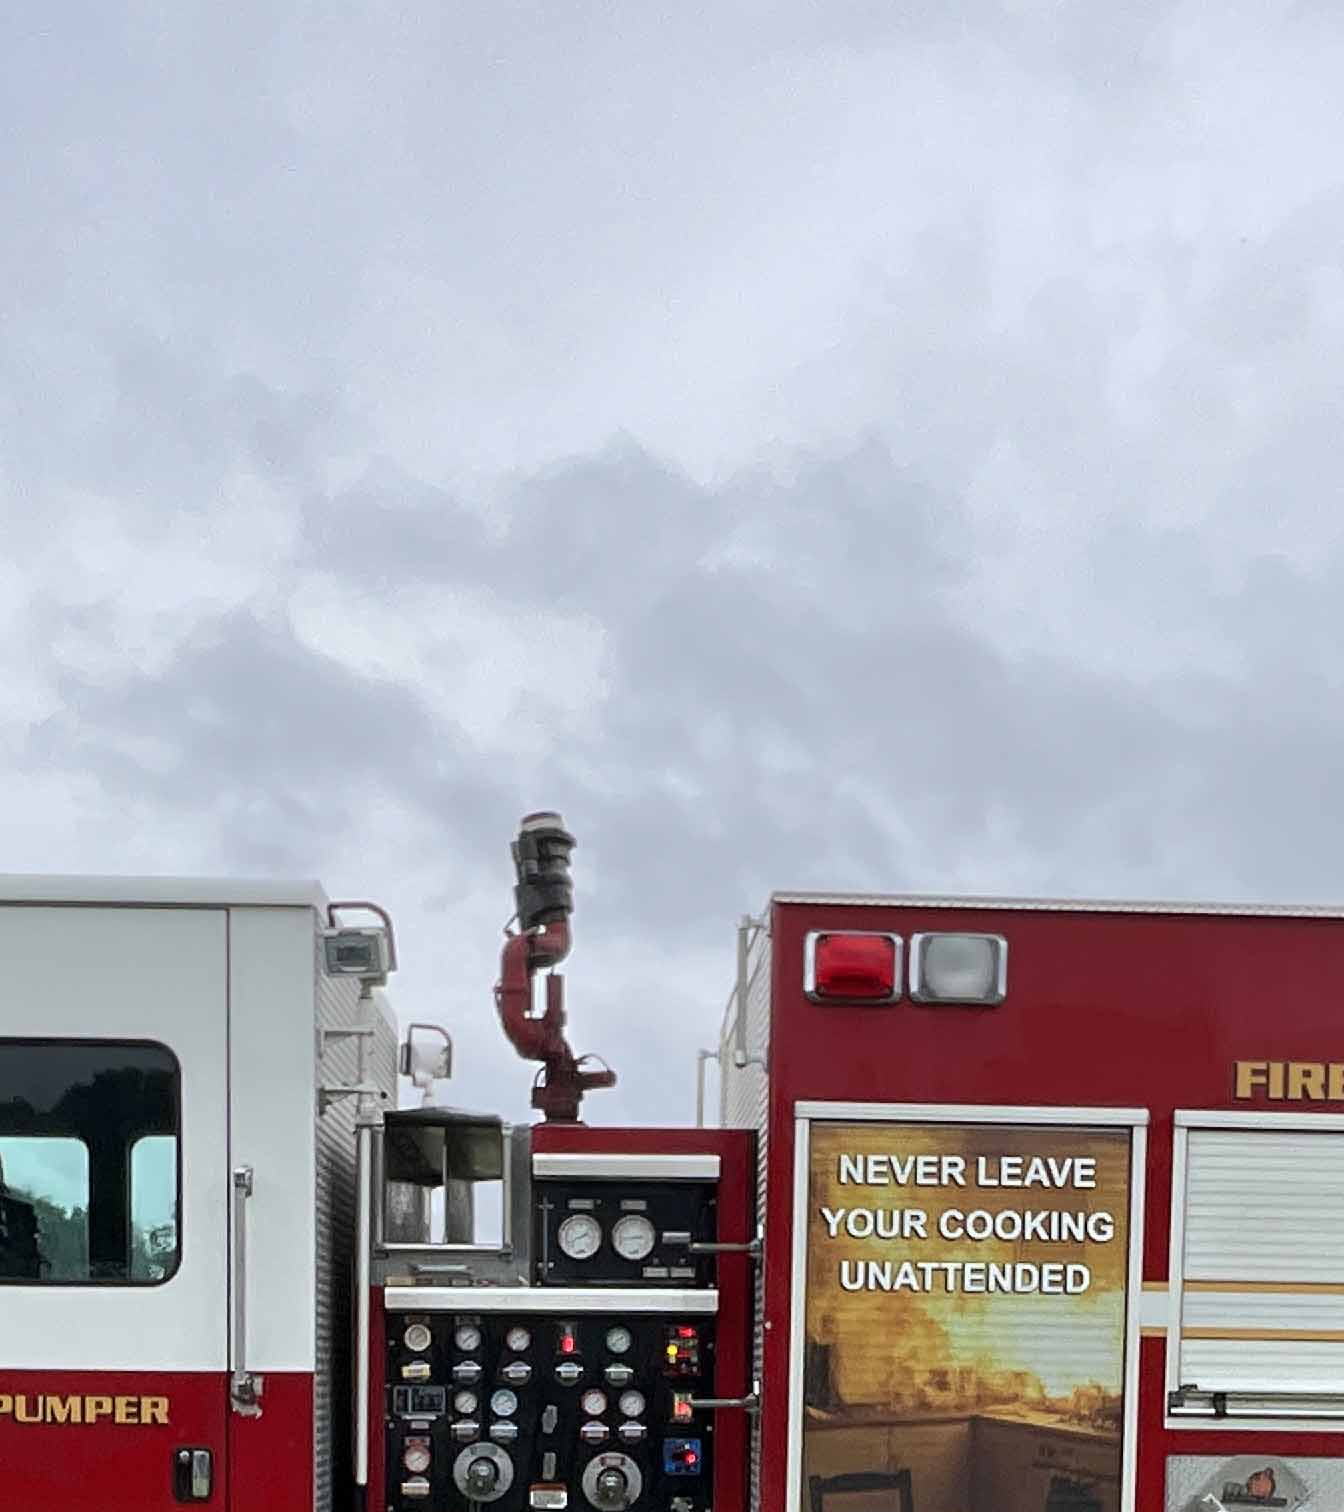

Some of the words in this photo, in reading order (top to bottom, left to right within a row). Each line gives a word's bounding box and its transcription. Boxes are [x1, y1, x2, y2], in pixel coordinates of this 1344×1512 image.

[839, 1153, 966, 1187] NEVER
[977, 1156, 1097, 1189] LEAVE
[820, 1206, 928, 1239] YOUR
[939, 1208, 1115, 1243] COOKING
[840, 1260, 1091, 1294] UNATTENDED
